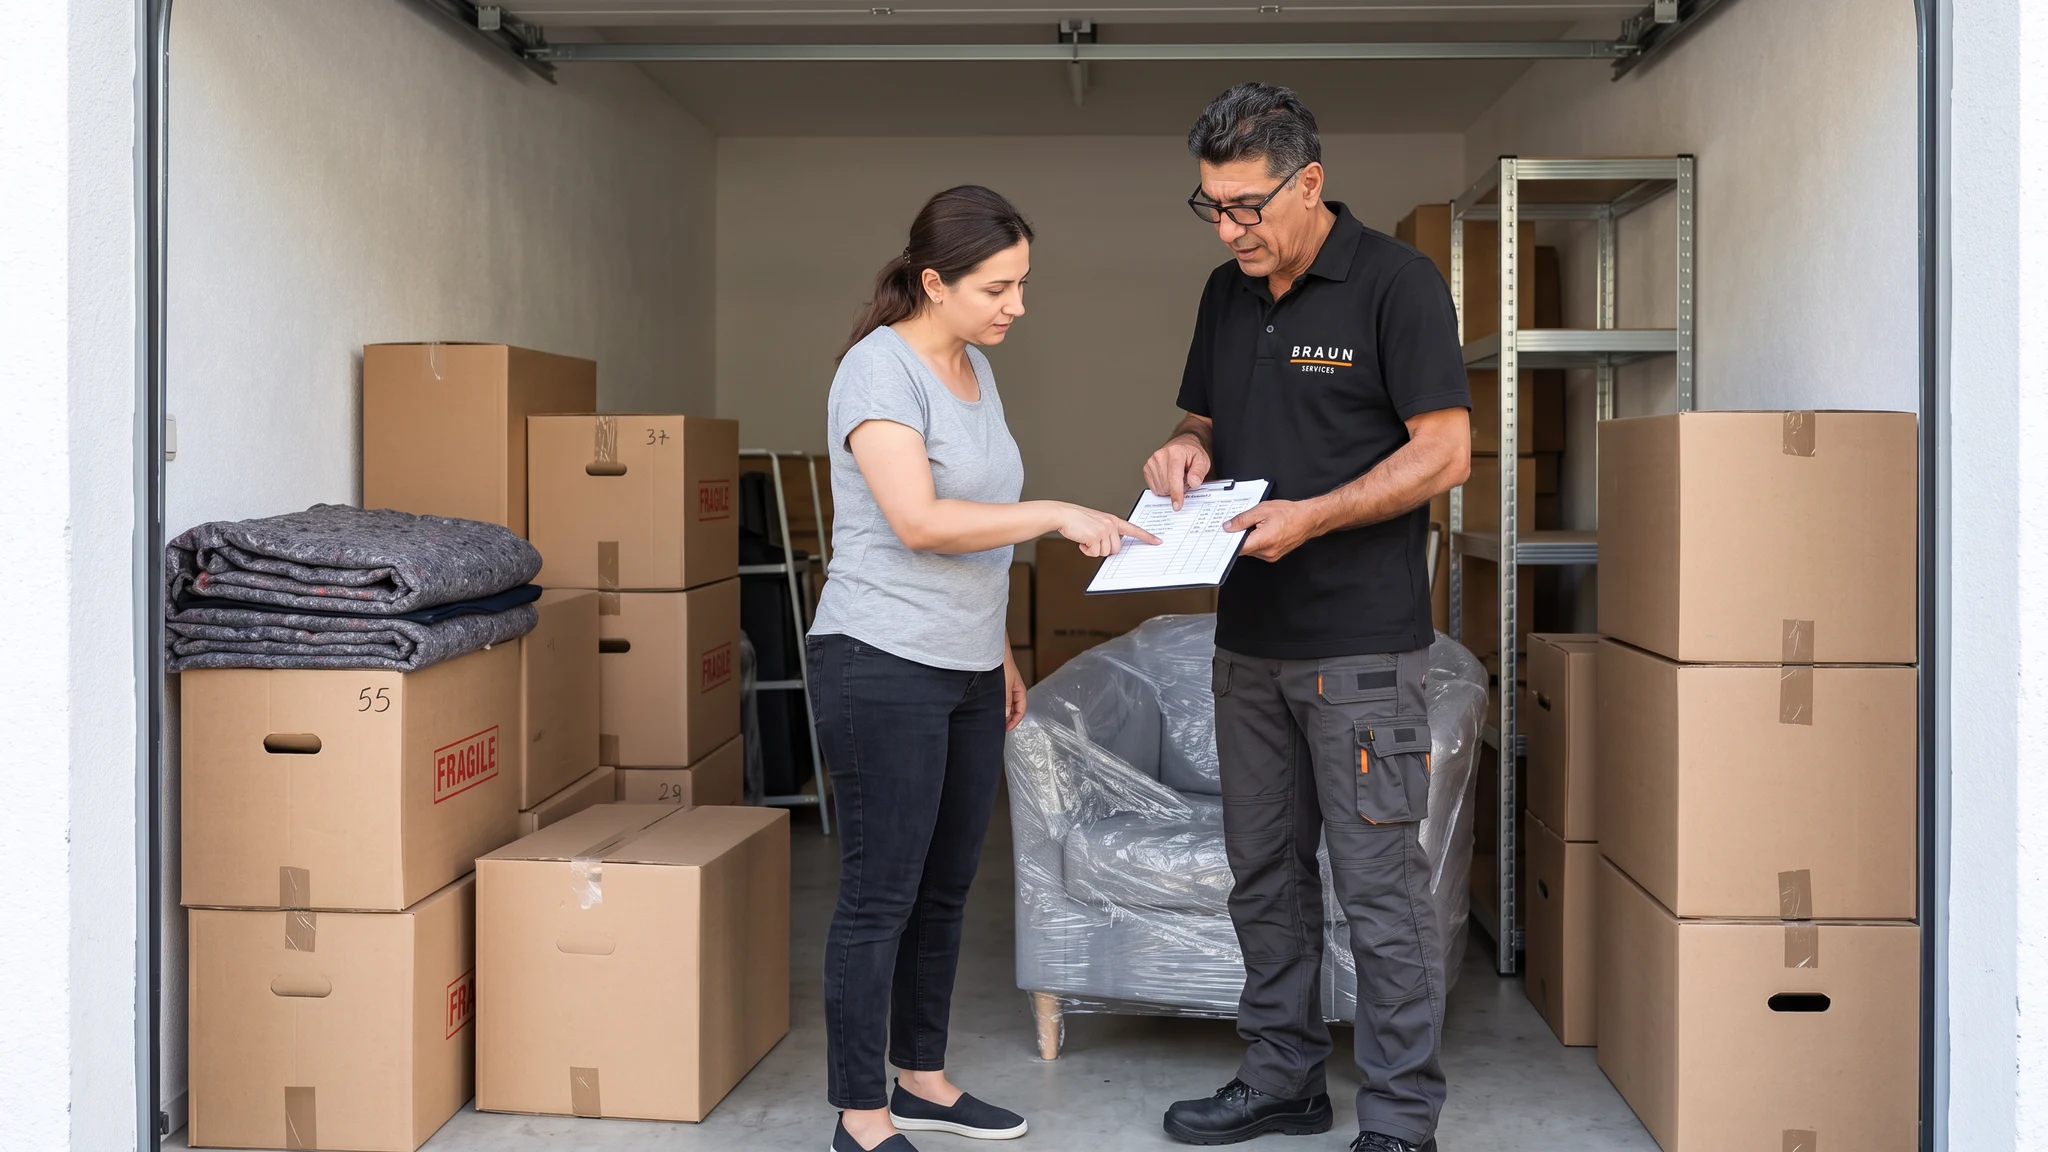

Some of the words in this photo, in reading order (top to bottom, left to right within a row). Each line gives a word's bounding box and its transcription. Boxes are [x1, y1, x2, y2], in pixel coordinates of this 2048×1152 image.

[1291, 346, 1353, 361] BRAUN
[1301, 365, 1335, 374] SERVICES
[646, 428, 670, 446] 37
[700, 486, 729, 514] FRAGILE
[702, 649, 731, 687] FRAGILE
[358, 686, 390, 713] 55
[437, 735, 496, 793] FRAGILE
